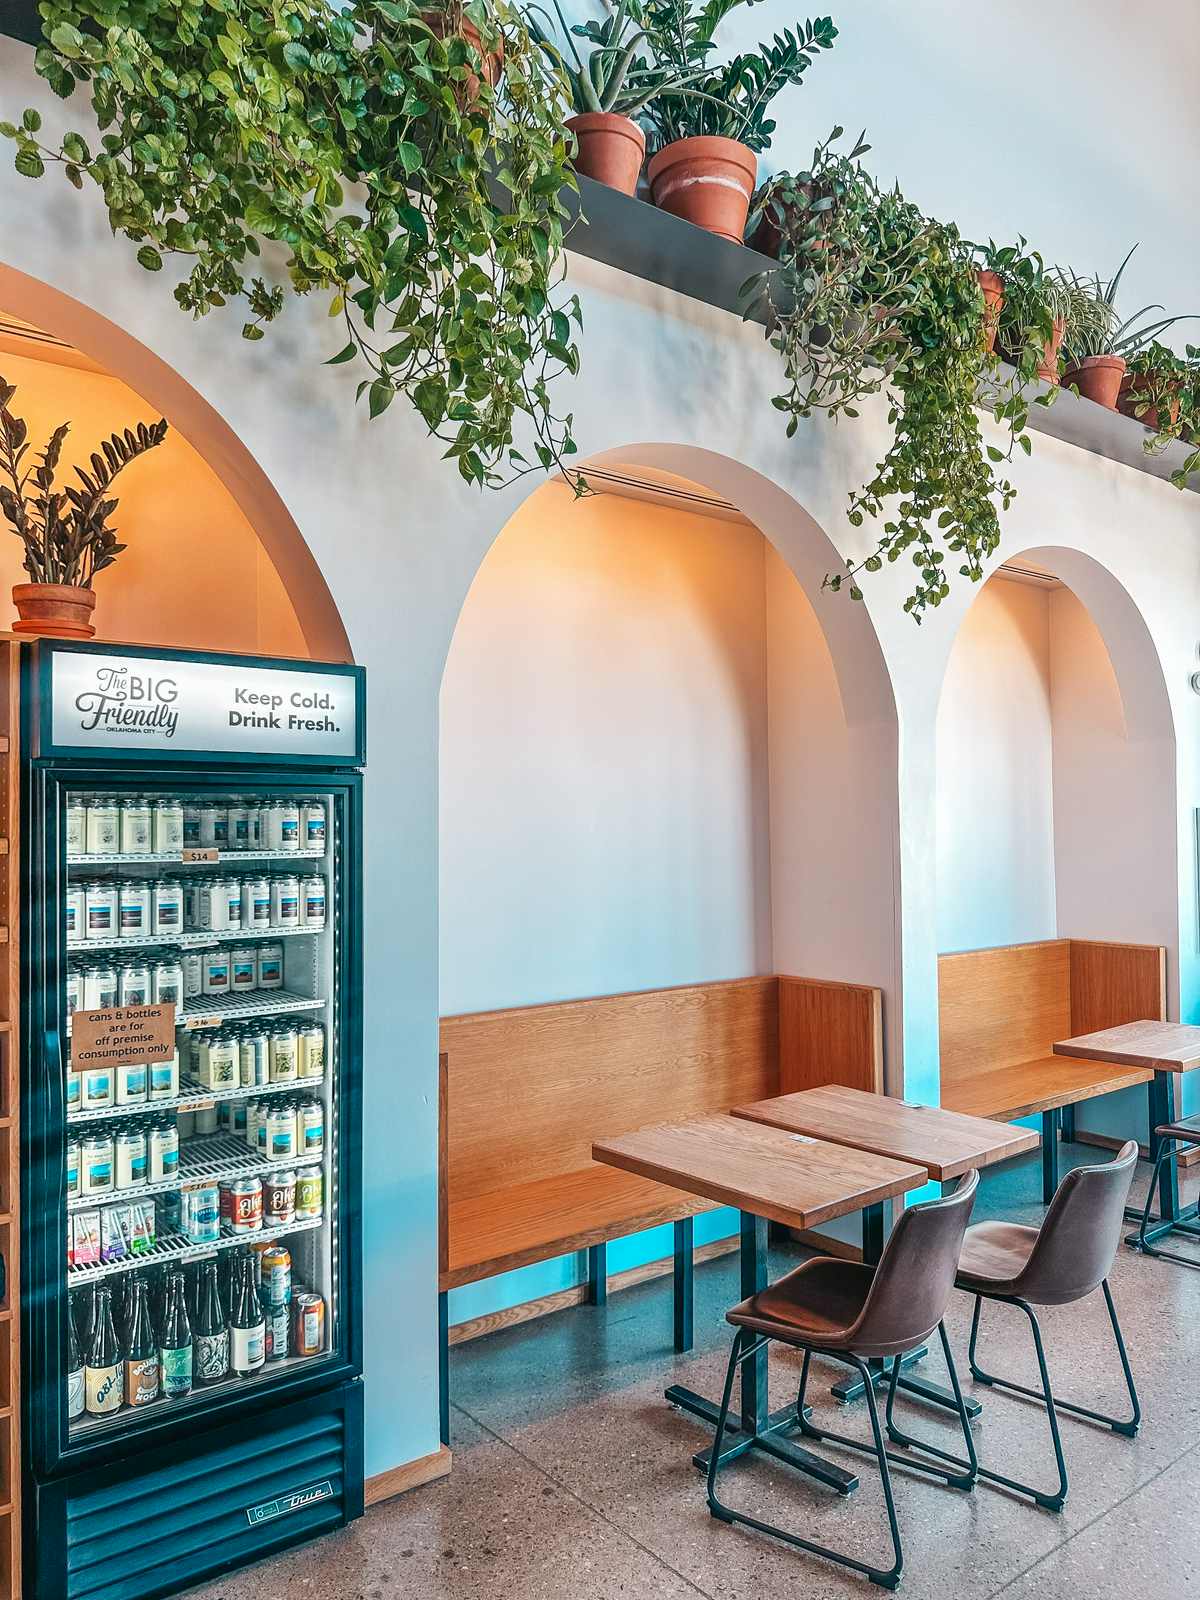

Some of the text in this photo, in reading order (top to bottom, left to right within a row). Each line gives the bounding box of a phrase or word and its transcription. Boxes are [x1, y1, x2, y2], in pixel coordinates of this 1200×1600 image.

[97, 668, 178, 703] The BIG
[235, 688, 335, 710] Keep Cold.
[76, 692, 179, 738] Friendly
[229, 711, 340, 732] Drink Fresh.
[106, 726, 142, 734] OKLAHOMA
[191, 852, 208, 861] $14
[88, 1008, 161, 1022] cans & bottles
[109, 1021, 144, 1032] are for
[95, 1033, 154, 1046] off premise
[78, 1043, 169, 1060] consumption only
[283, 1489, 326, 1507] true
